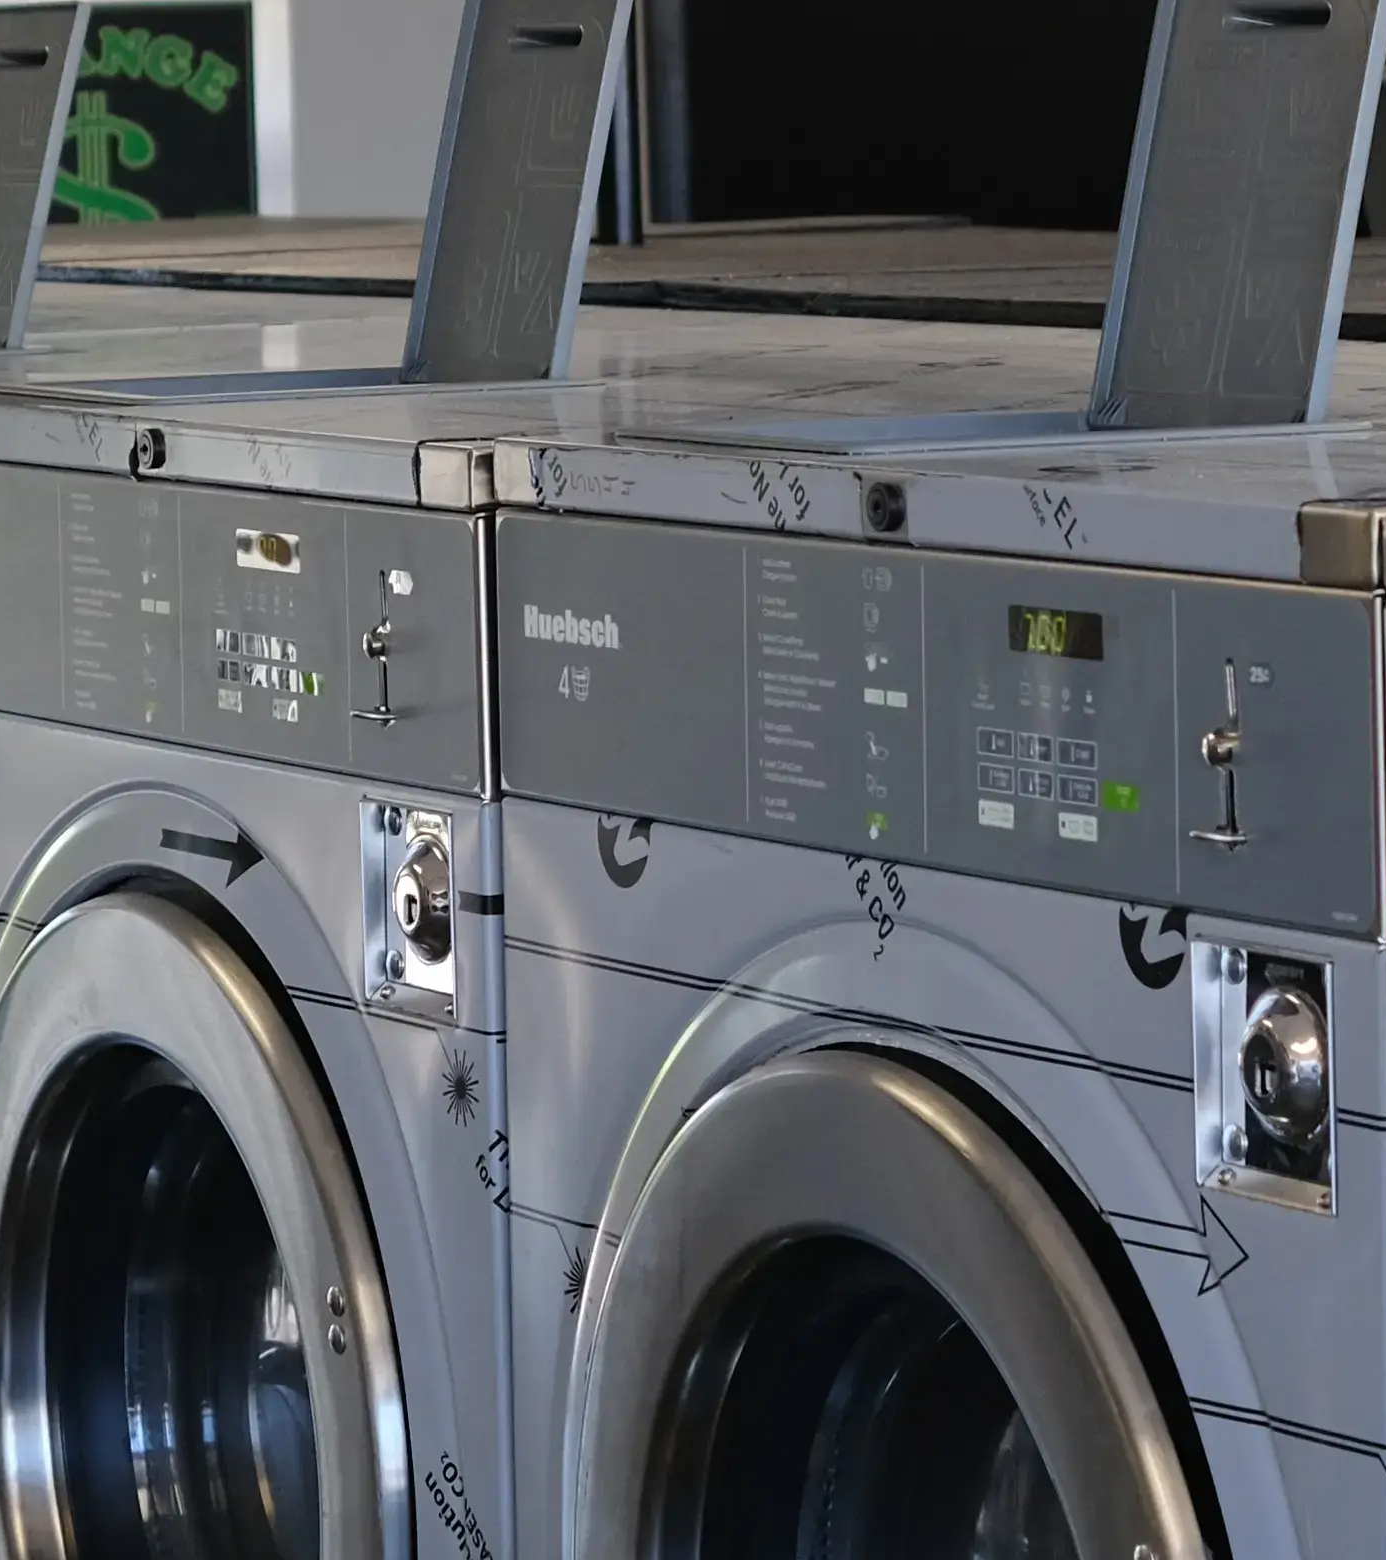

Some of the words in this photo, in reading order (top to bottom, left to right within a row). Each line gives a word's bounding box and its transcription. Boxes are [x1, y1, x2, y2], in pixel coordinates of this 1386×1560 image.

[523, 605, 619, 649] Huebsch
[558, 666, 569, 699] 4
[475, 1154, 495, 1189] for
